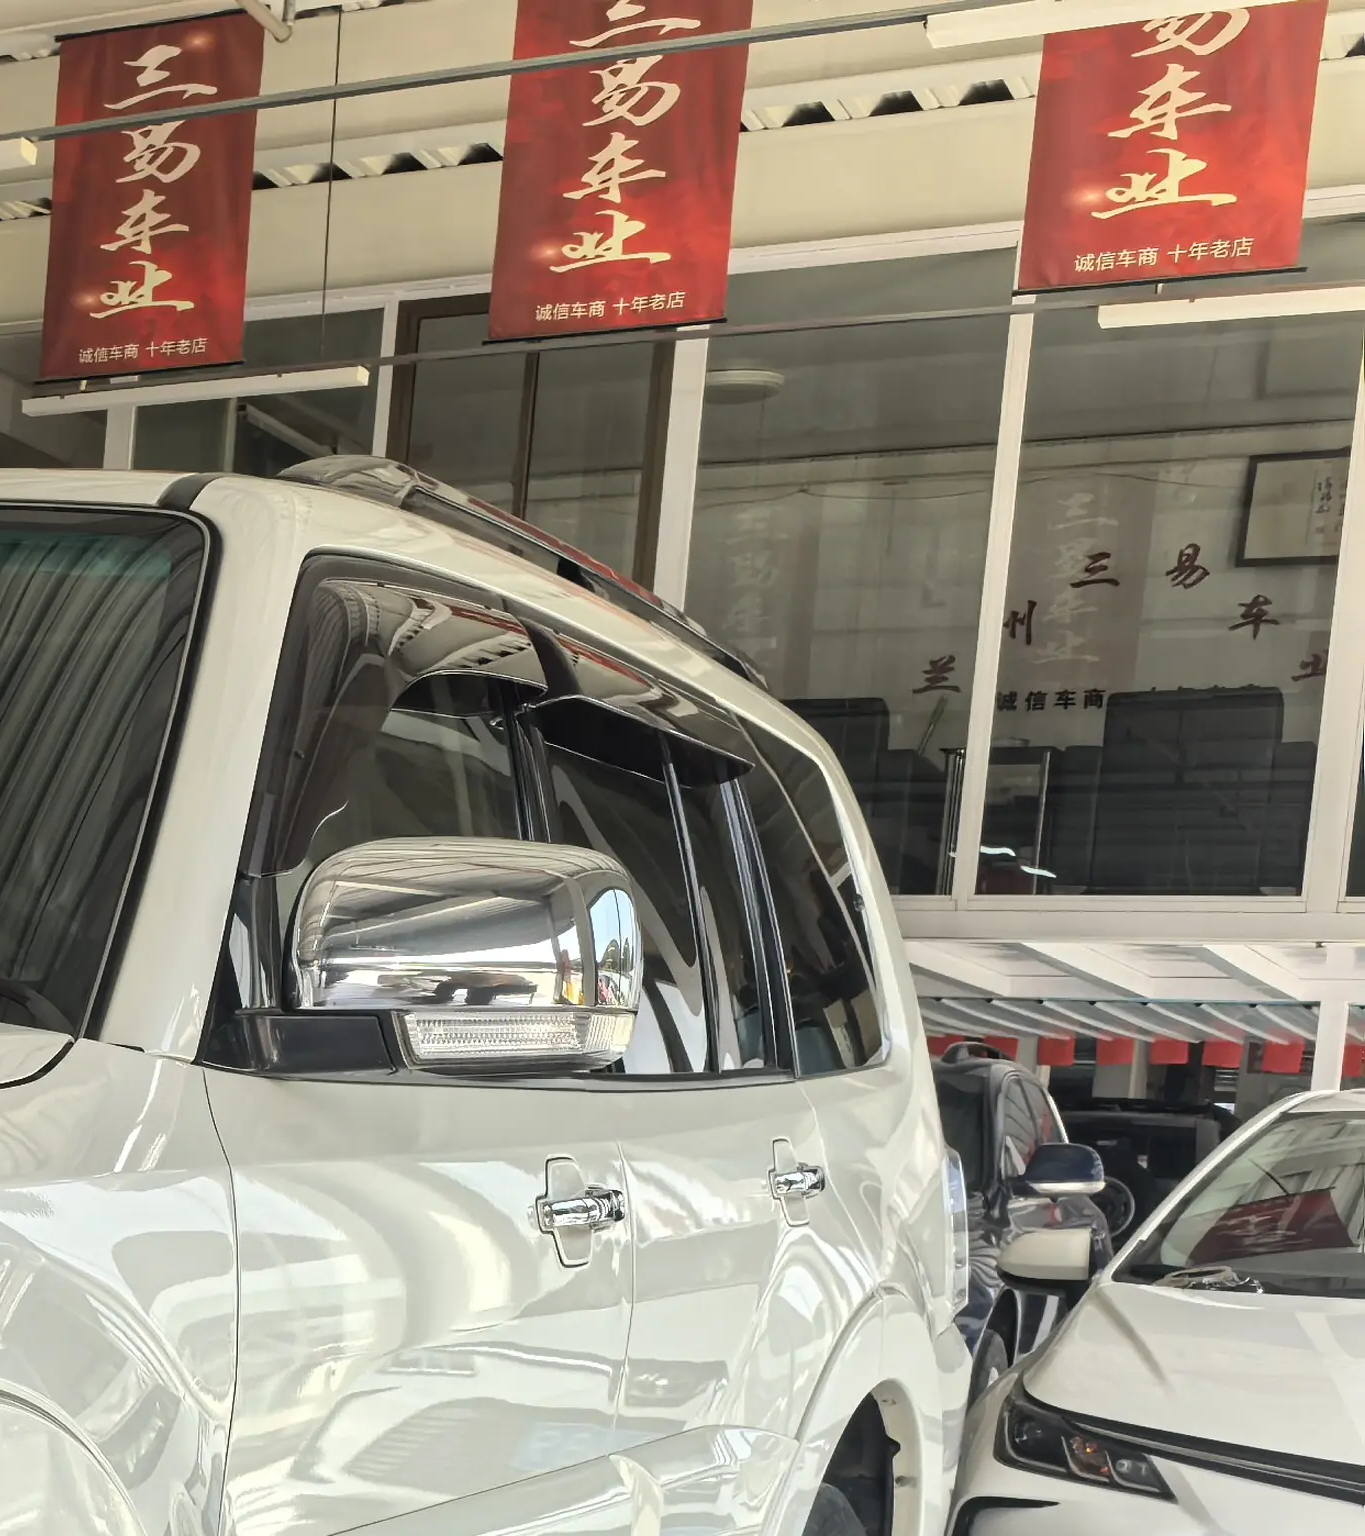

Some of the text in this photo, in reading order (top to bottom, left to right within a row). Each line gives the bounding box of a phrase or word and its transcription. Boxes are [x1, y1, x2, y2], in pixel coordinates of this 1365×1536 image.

[90, 45, 217, 319] 三易车业
[1074, 237, 1254, 272] 诚信车商 十年老店
[535, 291, 686, 321] 诚信车商 十年老店
[79, 338, 208, 363] 诚信车商 十年老店
